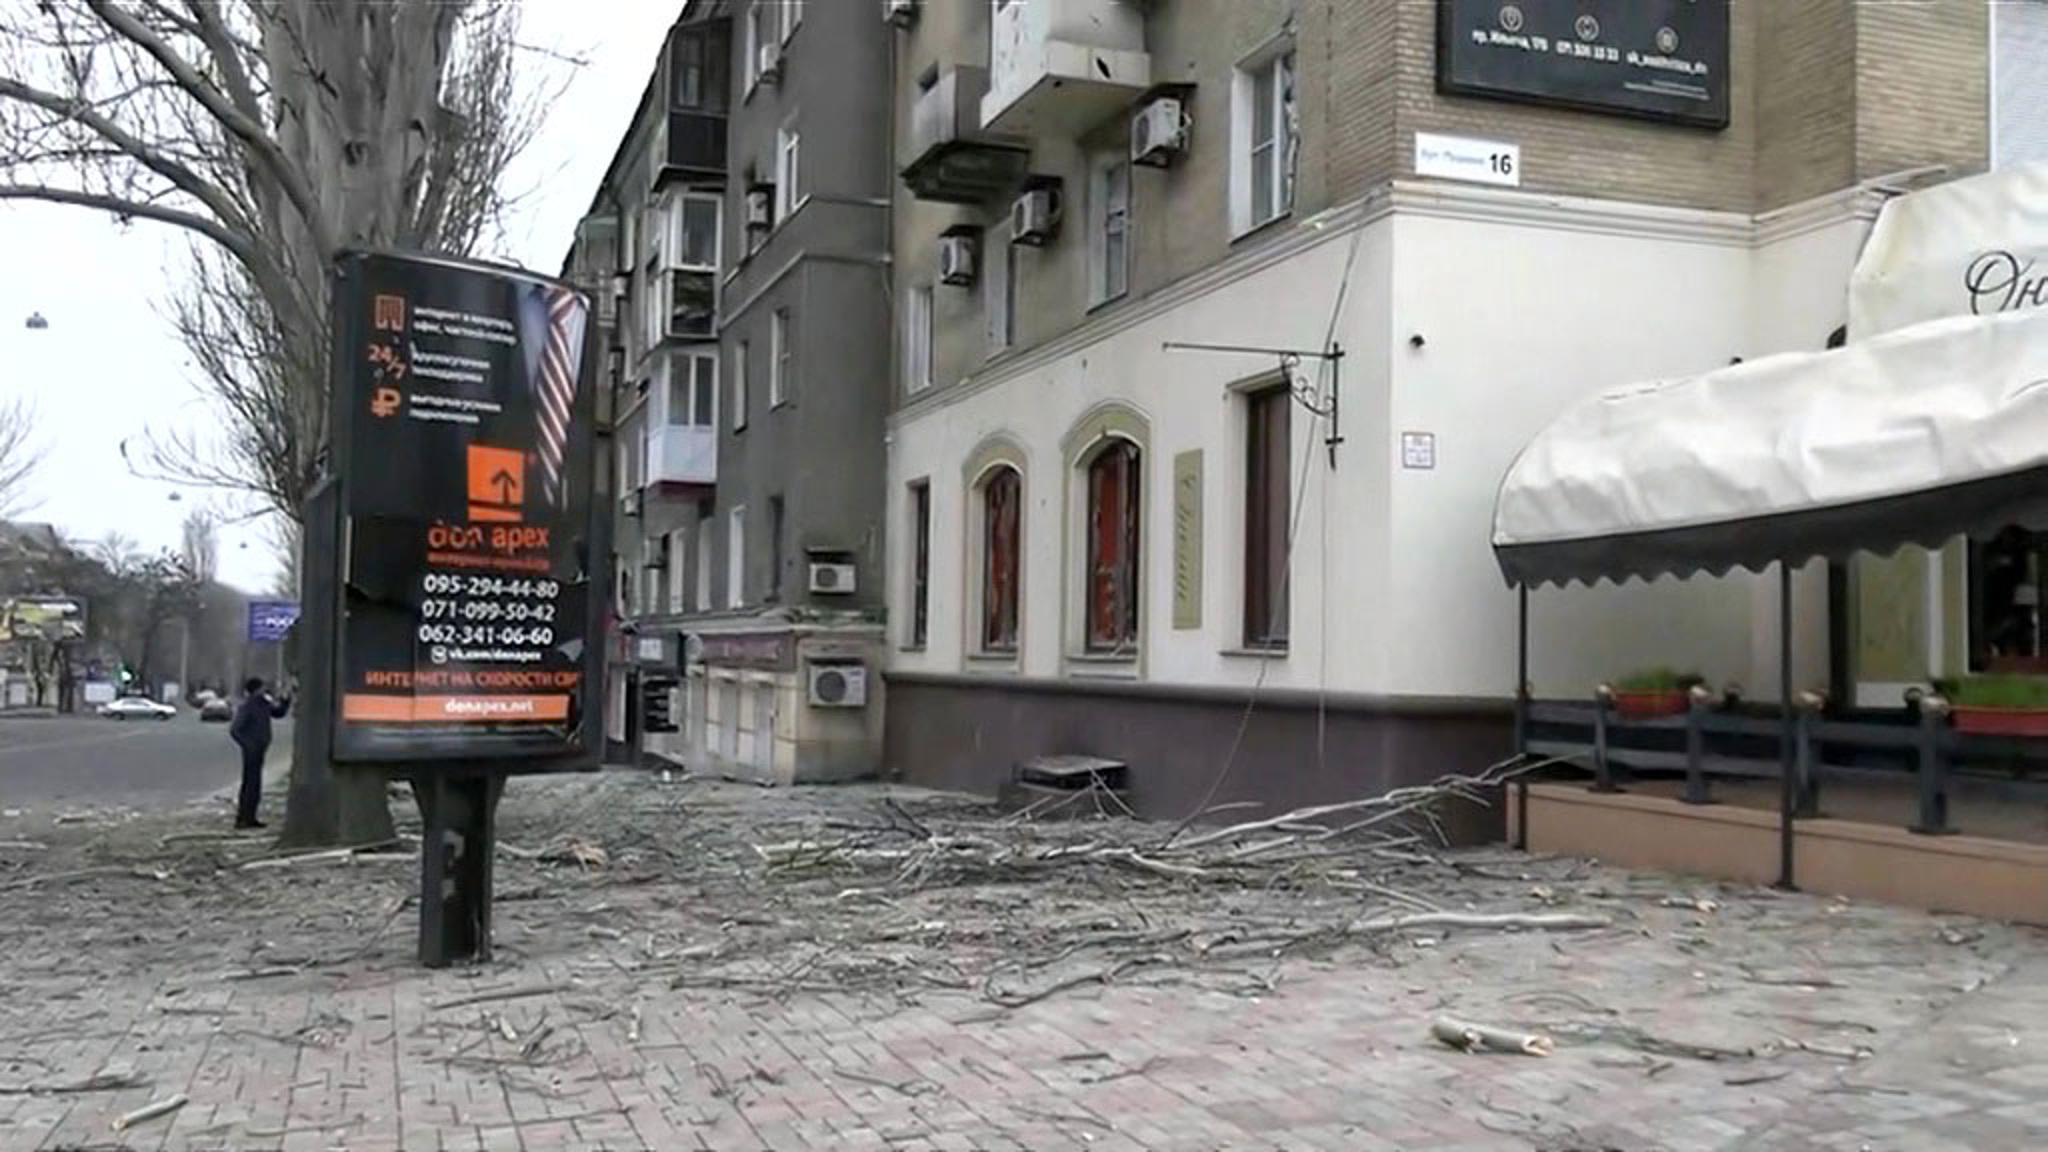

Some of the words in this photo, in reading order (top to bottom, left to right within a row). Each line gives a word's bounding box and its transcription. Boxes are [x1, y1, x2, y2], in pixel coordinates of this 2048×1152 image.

[1490, 153, 1512, 175] 16
[369, 344, 406, 380] 24/7
[491, 527, 548, 555] apex
[423, 573, 559, 598] 095-294-44-80
[421, 599, 556, 622] 071-099-50-42
[419, 624, 553, 645] 062-341-06-60
[365, 671, 449, 687] ИНТЕРНЕТ
[451, 672, 474, 686] НА
[476, 672, 550, 687] СКОРОСТИ
[445, 699, 533, 716] donapex.net
